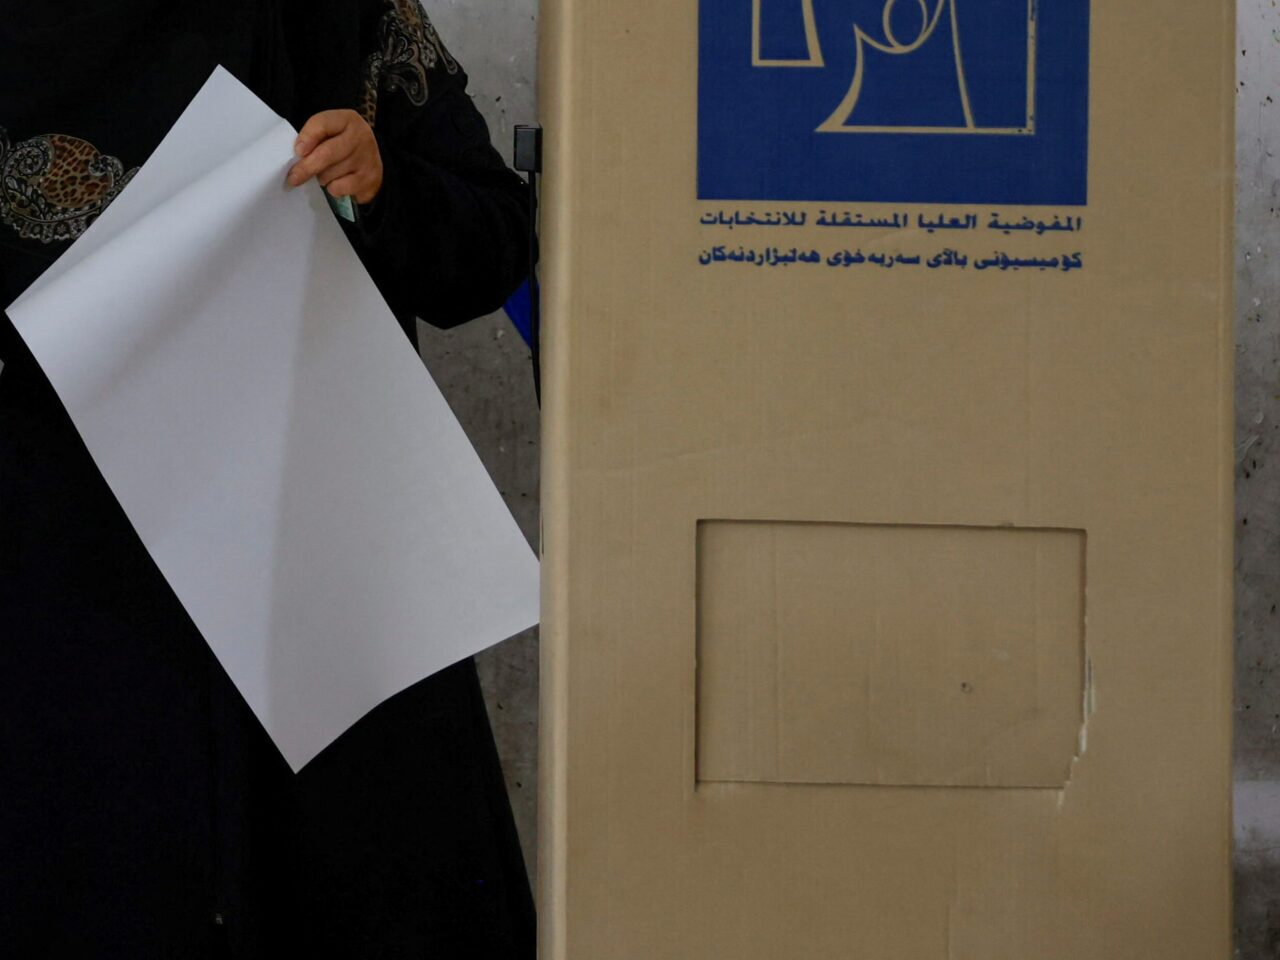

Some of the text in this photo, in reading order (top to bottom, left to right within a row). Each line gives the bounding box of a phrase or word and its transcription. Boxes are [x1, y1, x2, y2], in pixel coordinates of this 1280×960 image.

[699, 210, 1083, 235] المفوضية العليا المستقلة للانتخابات
